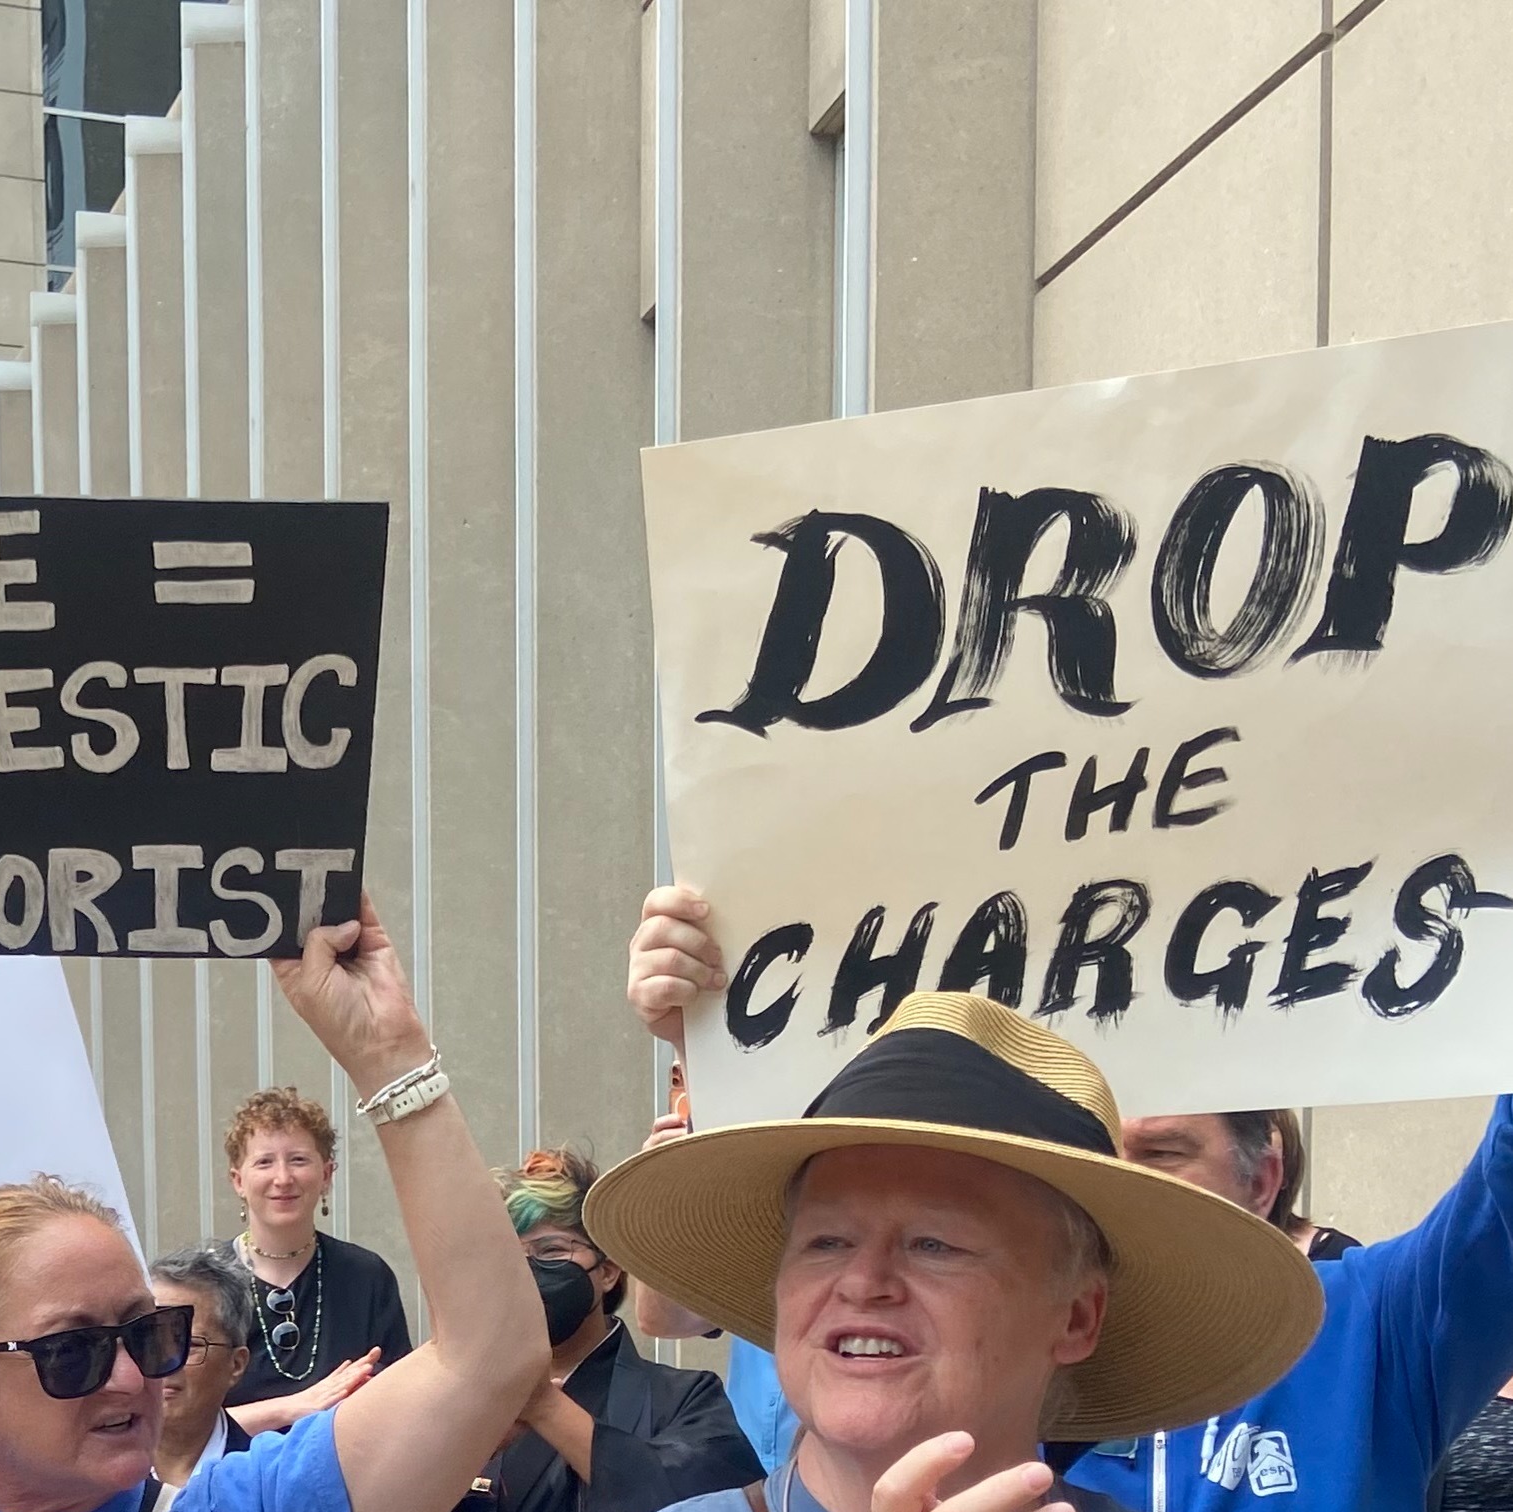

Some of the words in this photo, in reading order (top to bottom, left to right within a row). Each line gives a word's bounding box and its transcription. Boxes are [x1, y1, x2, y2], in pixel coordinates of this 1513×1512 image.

[695, 432, 1513, 738] DROP
[975, 725, 1241, 851] THE
[724, 853, 1513, 1053] CHARGES
